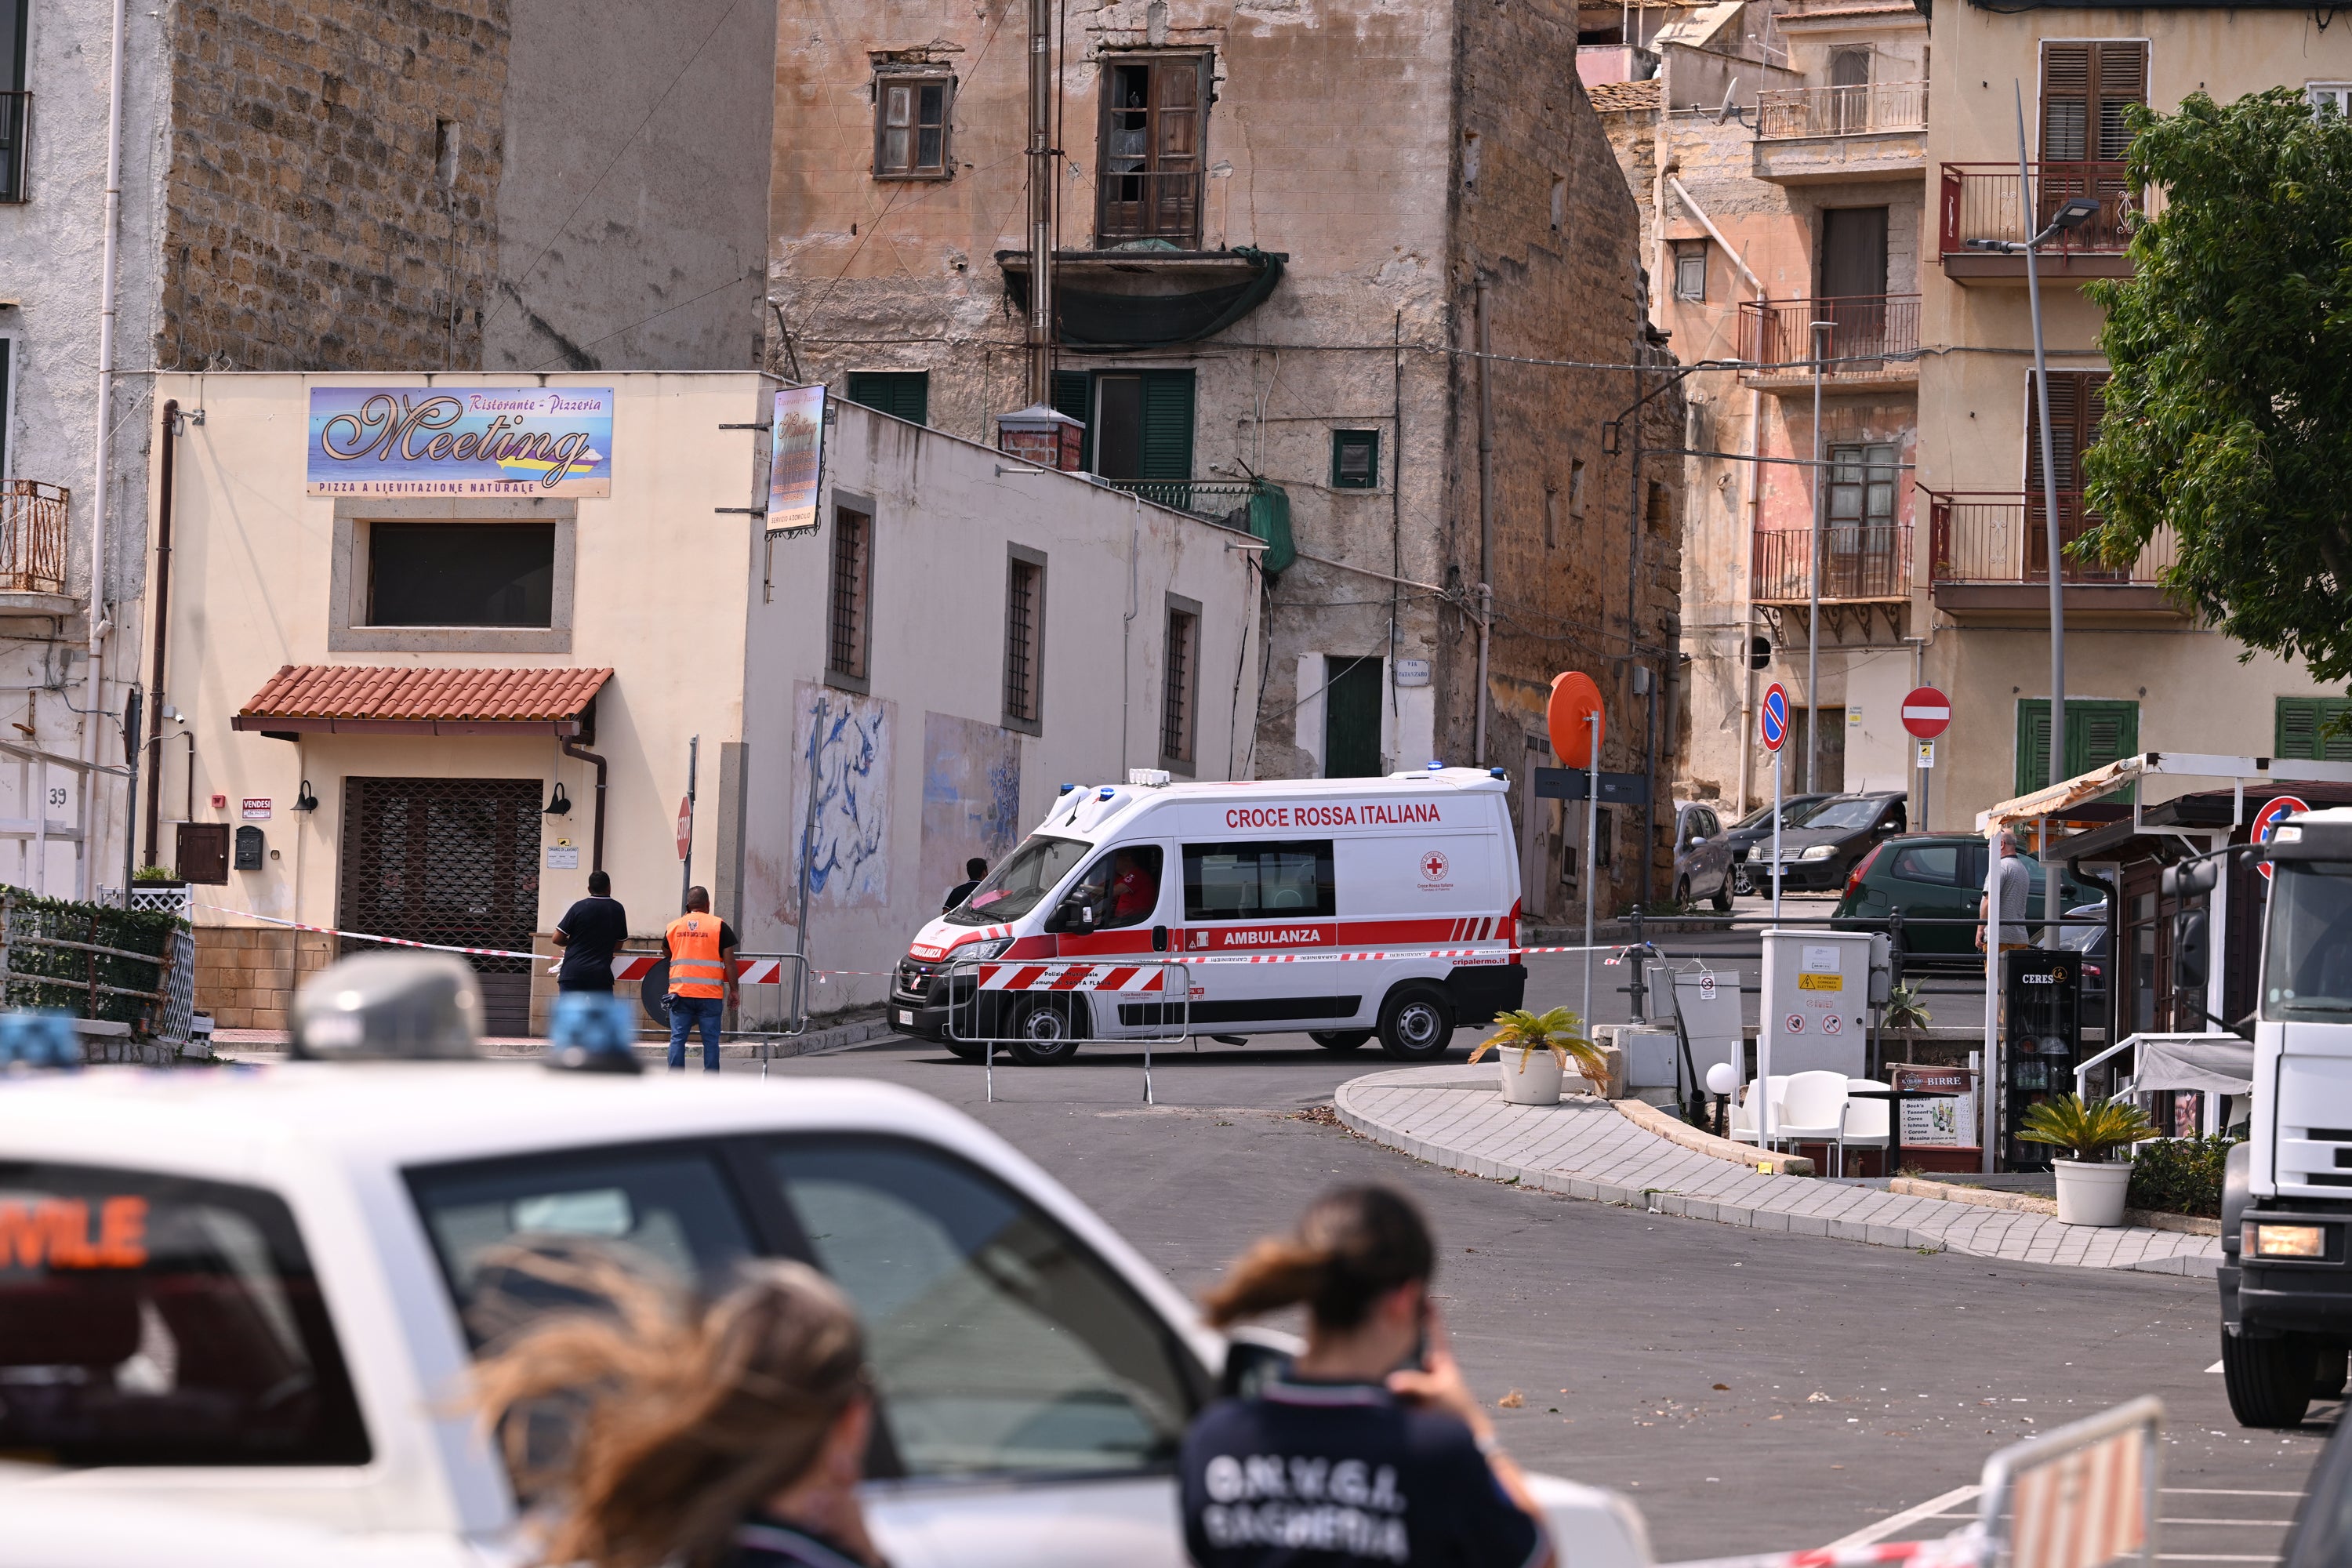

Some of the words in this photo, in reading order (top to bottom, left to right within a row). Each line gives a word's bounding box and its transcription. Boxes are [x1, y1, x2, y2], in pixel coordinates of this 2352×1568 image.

[469, 394, 535, 412] Ristorante
[549, 394, 602, 413] Pizzeria
[778, 412, 818, 445] Meeting
[321, 394, 590, 489] Meeting
[319, 482, 355, 492] PIZZA
[362, 482, 368, 492] A
[376, 482, 463, 492] LIEVITAZIONE
[470, 482, 534, 492] NATURALE
[49, 788, 67, 804] 39
[244, 800, 270, 808] VENDESI
[1226, 808, 1289, 828] CROCE
[1294, 806, 1357, 826] ROSSA
[1360, 804, 1441, 824] ITALIANA
[677, 817, 690, 840] STOP
[1224, 929, 1321, 946] AMBULANZA
[909, 945, 942, 958] AMBULANZA
[1452, 957, 1506, 966] cripalermo.it
[2023, 974, 2054, 984] CERES
[1927, 1076, 1962, 1085] BIRRE
